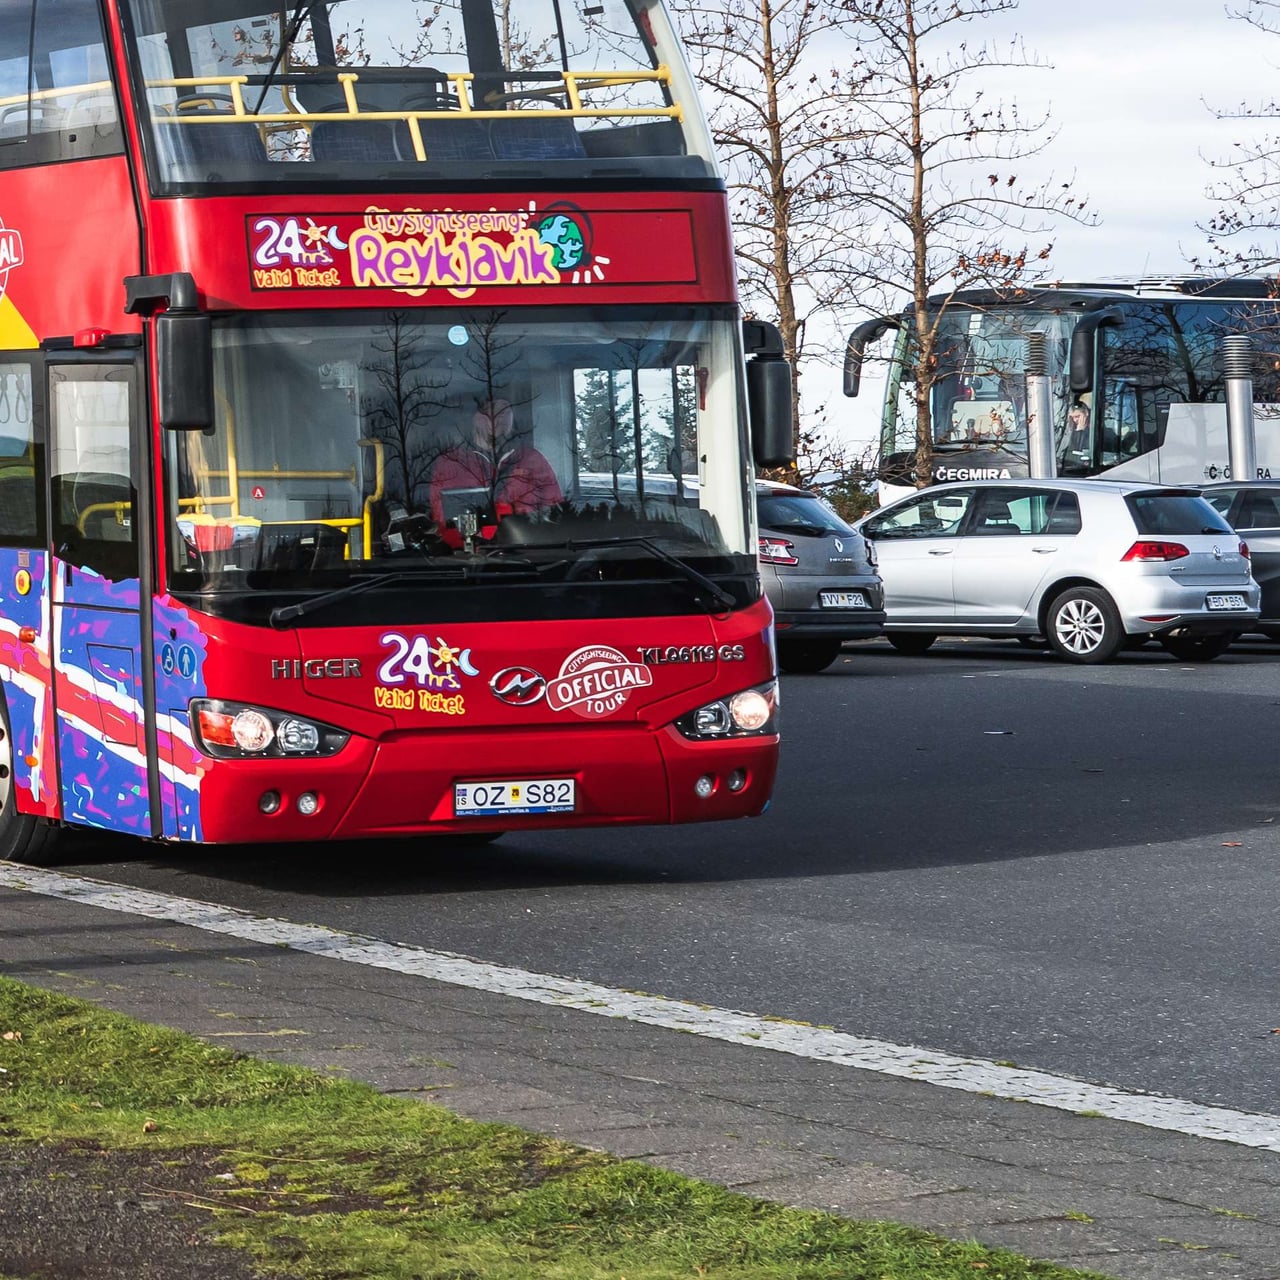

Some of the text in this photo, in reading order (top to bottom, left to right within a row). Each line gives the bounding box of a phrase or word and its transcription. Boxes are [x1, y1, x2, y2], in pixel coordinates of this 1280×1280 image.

[351, 231, 559, 297] Reykjavik
[254, 266, 341, 288] Valid Ticket
[935, 466, 1012, 481] ČEGMIRA
[271, 658, 362, 680] HIGER
[568, 649, 622, 673] CITYSIGHTSEEING
[556, 667, 646, 703] OFFICIAL
[374, 686, 465, 715] Valid Ticket
[586, 692, 626, 714] TOUR
[457, 797, 467, 806] IS
[473, 786, 505, 806] OZ
[526, 783, 571, 804] S82
